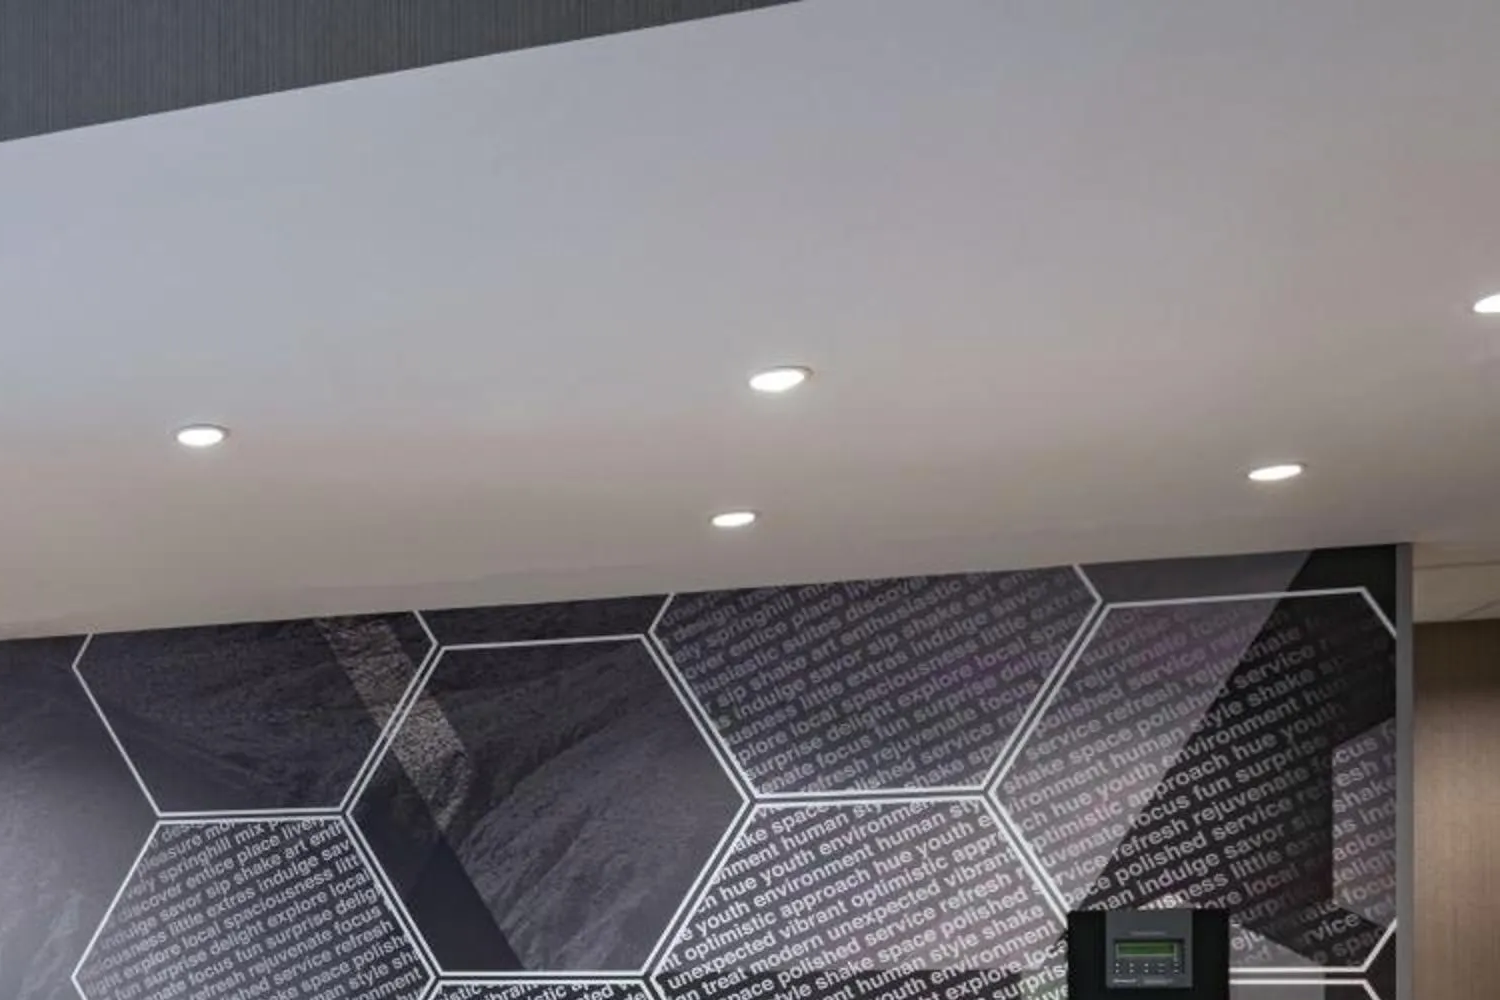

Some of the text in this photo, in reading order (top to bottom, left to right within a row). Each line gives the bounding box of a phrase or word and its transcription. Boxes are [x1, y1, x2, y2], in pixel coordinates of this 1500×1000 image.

[729, 594, 843, 656] entice place
[749, 638, 838, 690] shake art
[782, 616, 841, 653] suites
[798, 612, 987, 710] little extras indulge
[809, 602, 962, 683] savor sip shake
[1074, 633, 1187, 692] rejuvenate
[789, 639, 978, 736] local spaciousness
[816, 675, 996, 767] focus fun surprise
[826, 636, 1026, 741] delight explore local
[871, 679, 1037, 764] rejuvenate focus
[997, 645, 1315, 793] shake space polished service
[1019, 682, 1181, 760] service refresh
[1028, 648, 1206, 733] polished service
[1109, 669, 1314, 768] human style shake
[919, 721, 993, 764] service
[1050, 697, 1300, 816] hue youth environment
[1126, 734, 1276, 807] approach hue
[780, 813, 848, 850] human
[1110, 764, 1314, 860] refresh rejuvenate
[1114, 797, 1292, 886] polished service
[1127, 777, 1231, 828] focus fun
[158, 836, 232, 882] springhill
[159, 839, 307, 921] savor sip shake art
[168, 855, 319, 935] little extras indulge
[185, 835, 280, 888] entice place
[683, 822, 973, 960] optimistic approach hue youth
[695, 812, 947, 935] youth environment human
[719, 849, 815, 900] hue youth
[1136, 823, 1285, 895] indulge savor
[1229, 850, 1280, 879] little
[1242, 862, 1299, 897] local
[122, 868, 333, 978] explore local spaciousness
[143, 950, 207, 988] surprise
[209, 920, 264, 955] delight
[267, 891, 328, 927] explore
[188, 909, 333, 985] focus fun surprise
[248, 929, 332, 977] rejuvenate
[333, 906, 381, 934] focus
[273, 950, 331, 984] service
[334, 920, 393, 955] refresh
[667, 856, 948, 989] unexpected vibrant optimistic
[701, 878, 940, 995] treat modern unexpected
[777, 937, 860, 988] polished
[864, 907, 935, 946] service
[939, 873, 1012, 912] refresh
[815, 957, 874, 989] shake
[877, 929, 936, 962] space
[939, 885, 1028, 938] polished
[855, 956, 927, 993] human
[929, 933, 978, 962] style
[981, 904, 1044, 939] shake
[930, 919, 1060, 984] environment
[301, 961, 350, 991] space
[347, 963, 388, 989] style
[944, 958, 1022, 1000] explore
